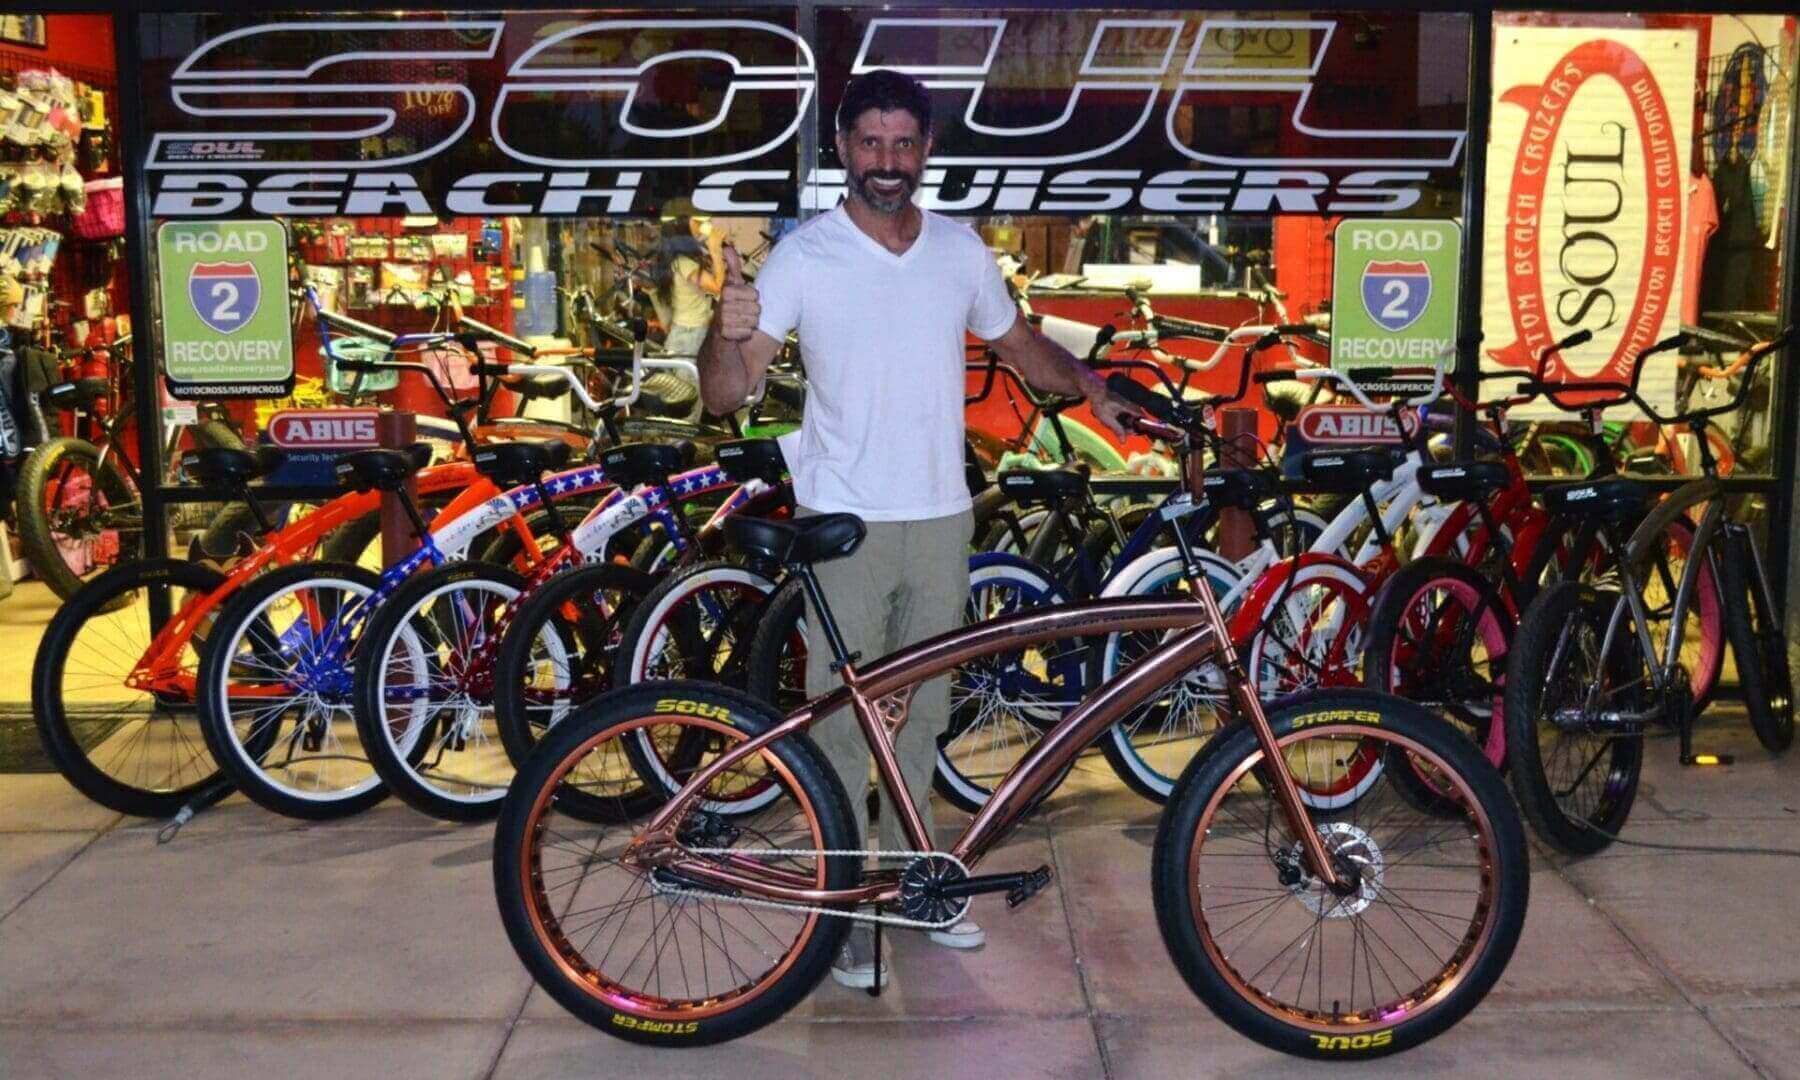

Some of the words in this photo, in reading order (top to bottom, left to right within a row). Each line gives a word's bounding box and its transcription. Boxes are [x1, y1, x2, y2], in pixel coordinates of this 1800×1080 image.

[143, 18, 1467, 169] SOUL
[1521, 62, 1583, 176] CRUZERS
[1631, 78, 1673, 187] CALIFORNIA
[152, 171, 642, 216] BEACH
[1352, 229, 1443, 251] ROAD
[1513, 193, 1537, 276] BEACH
[1556, 121, 1630, 332] SOUL
[1655, 197, 1675, 257] BEACH
[175, 230, 268, 254] ROAD
[211, 282, 240, 321] 2
[1381, 279, 1410, 319] 2
[1615, 265, 1667, 377] HUNTINGTON
[172, 340, 283, 362] RECOVERY
[1338, 337, 1448, 360] RECOVERY
[1517, 292, 1566, 384] USTOM
[174, 384, 286, 395] MOTOCROSS/SUPERCROSS
[285, 419, 376, 441] ABUS
[1314, 415, 1400, 437] ABUS
[288, 453, 320, 463] Security
[654, 698, 735, 725] SOUL
[1291, 710, 1382, 728] STOMPER
[611, 1013, 699, 1035] STOMPER
[1310, 1029, 1392, 1051] SOUL
